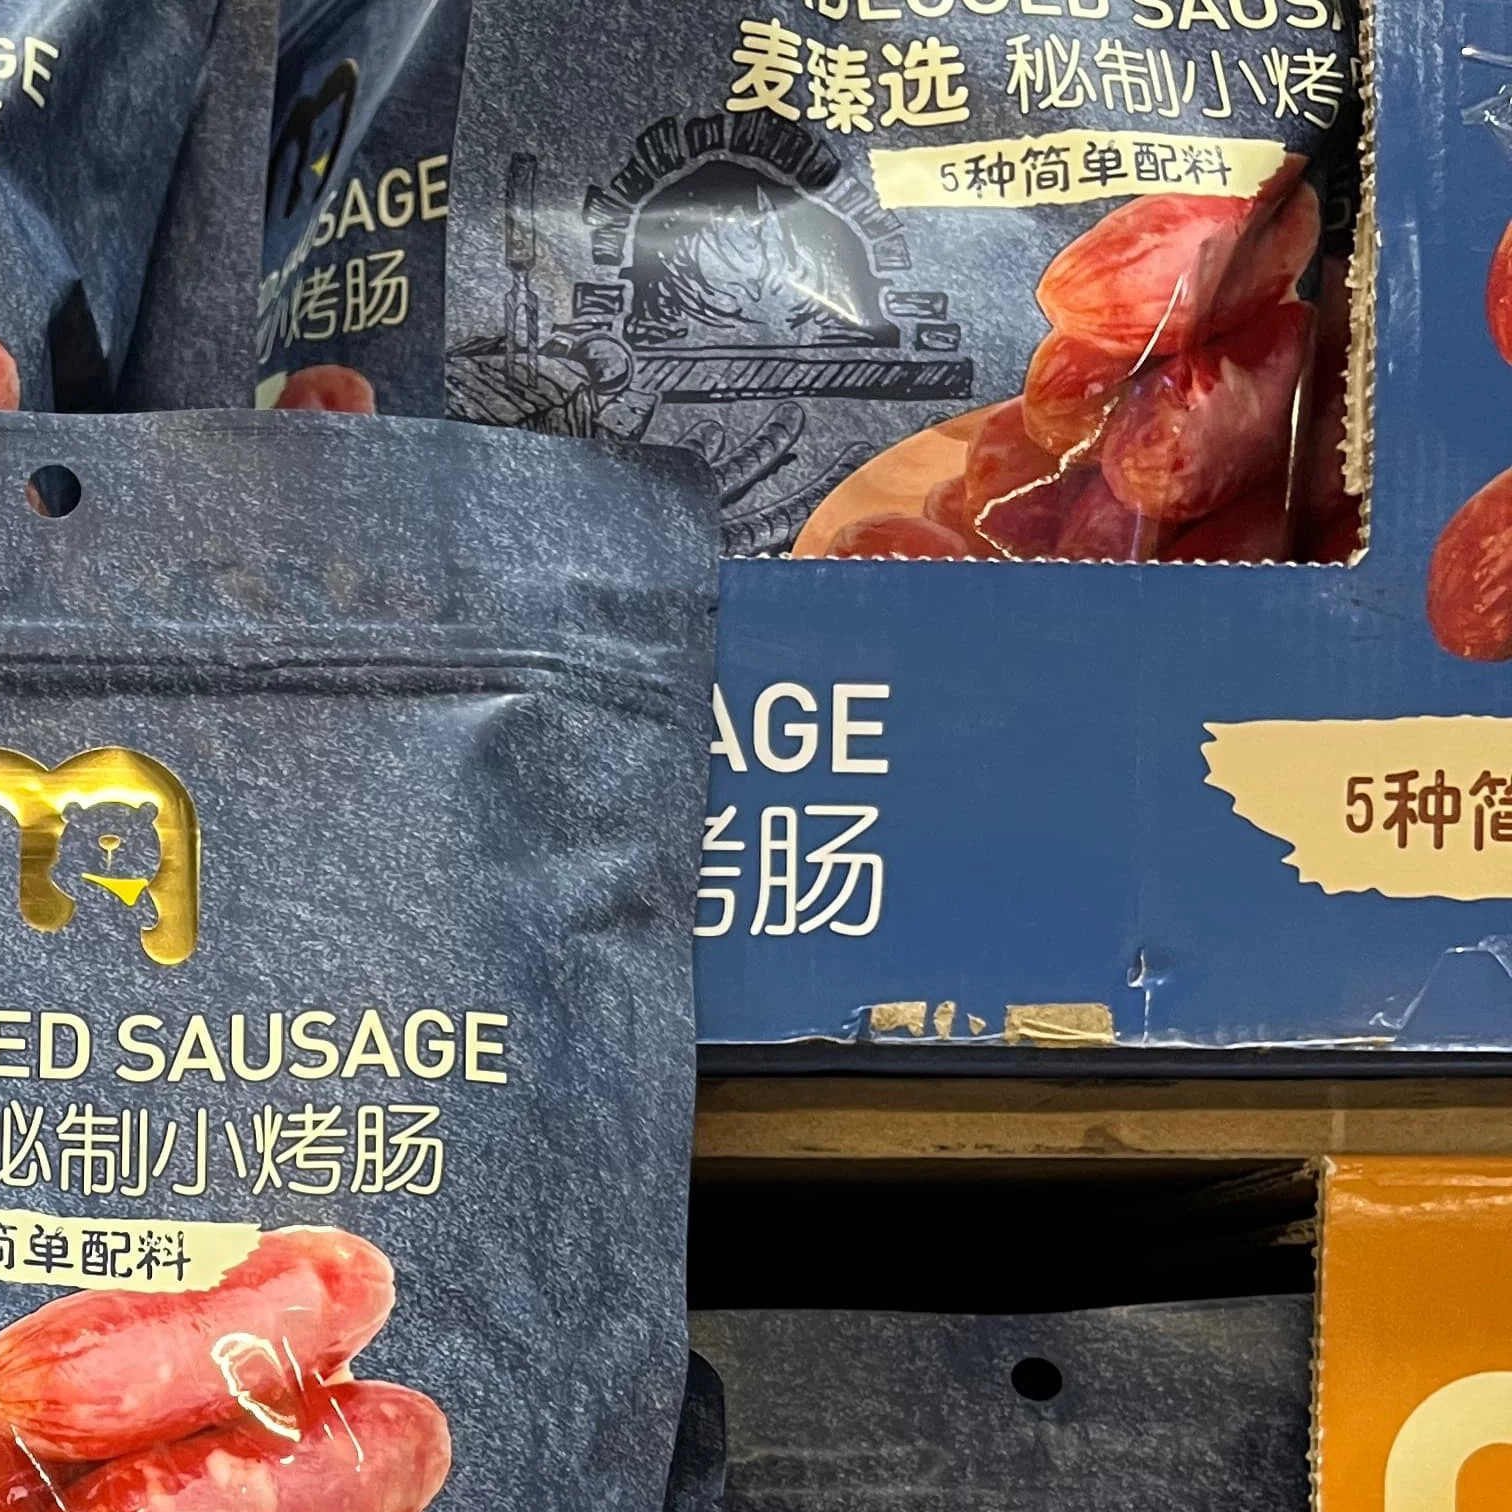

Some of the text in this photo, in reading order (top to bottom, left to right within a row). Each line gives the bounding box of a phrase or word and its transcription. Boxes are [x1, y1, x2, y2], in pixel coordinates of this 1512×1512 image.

[726, 18, 1364, 133] 麦臻选 秘制小烤
[941, 140, 1232, 198] 5种简单配料
[116, 1011, 509, 1085] SAUSAGE
